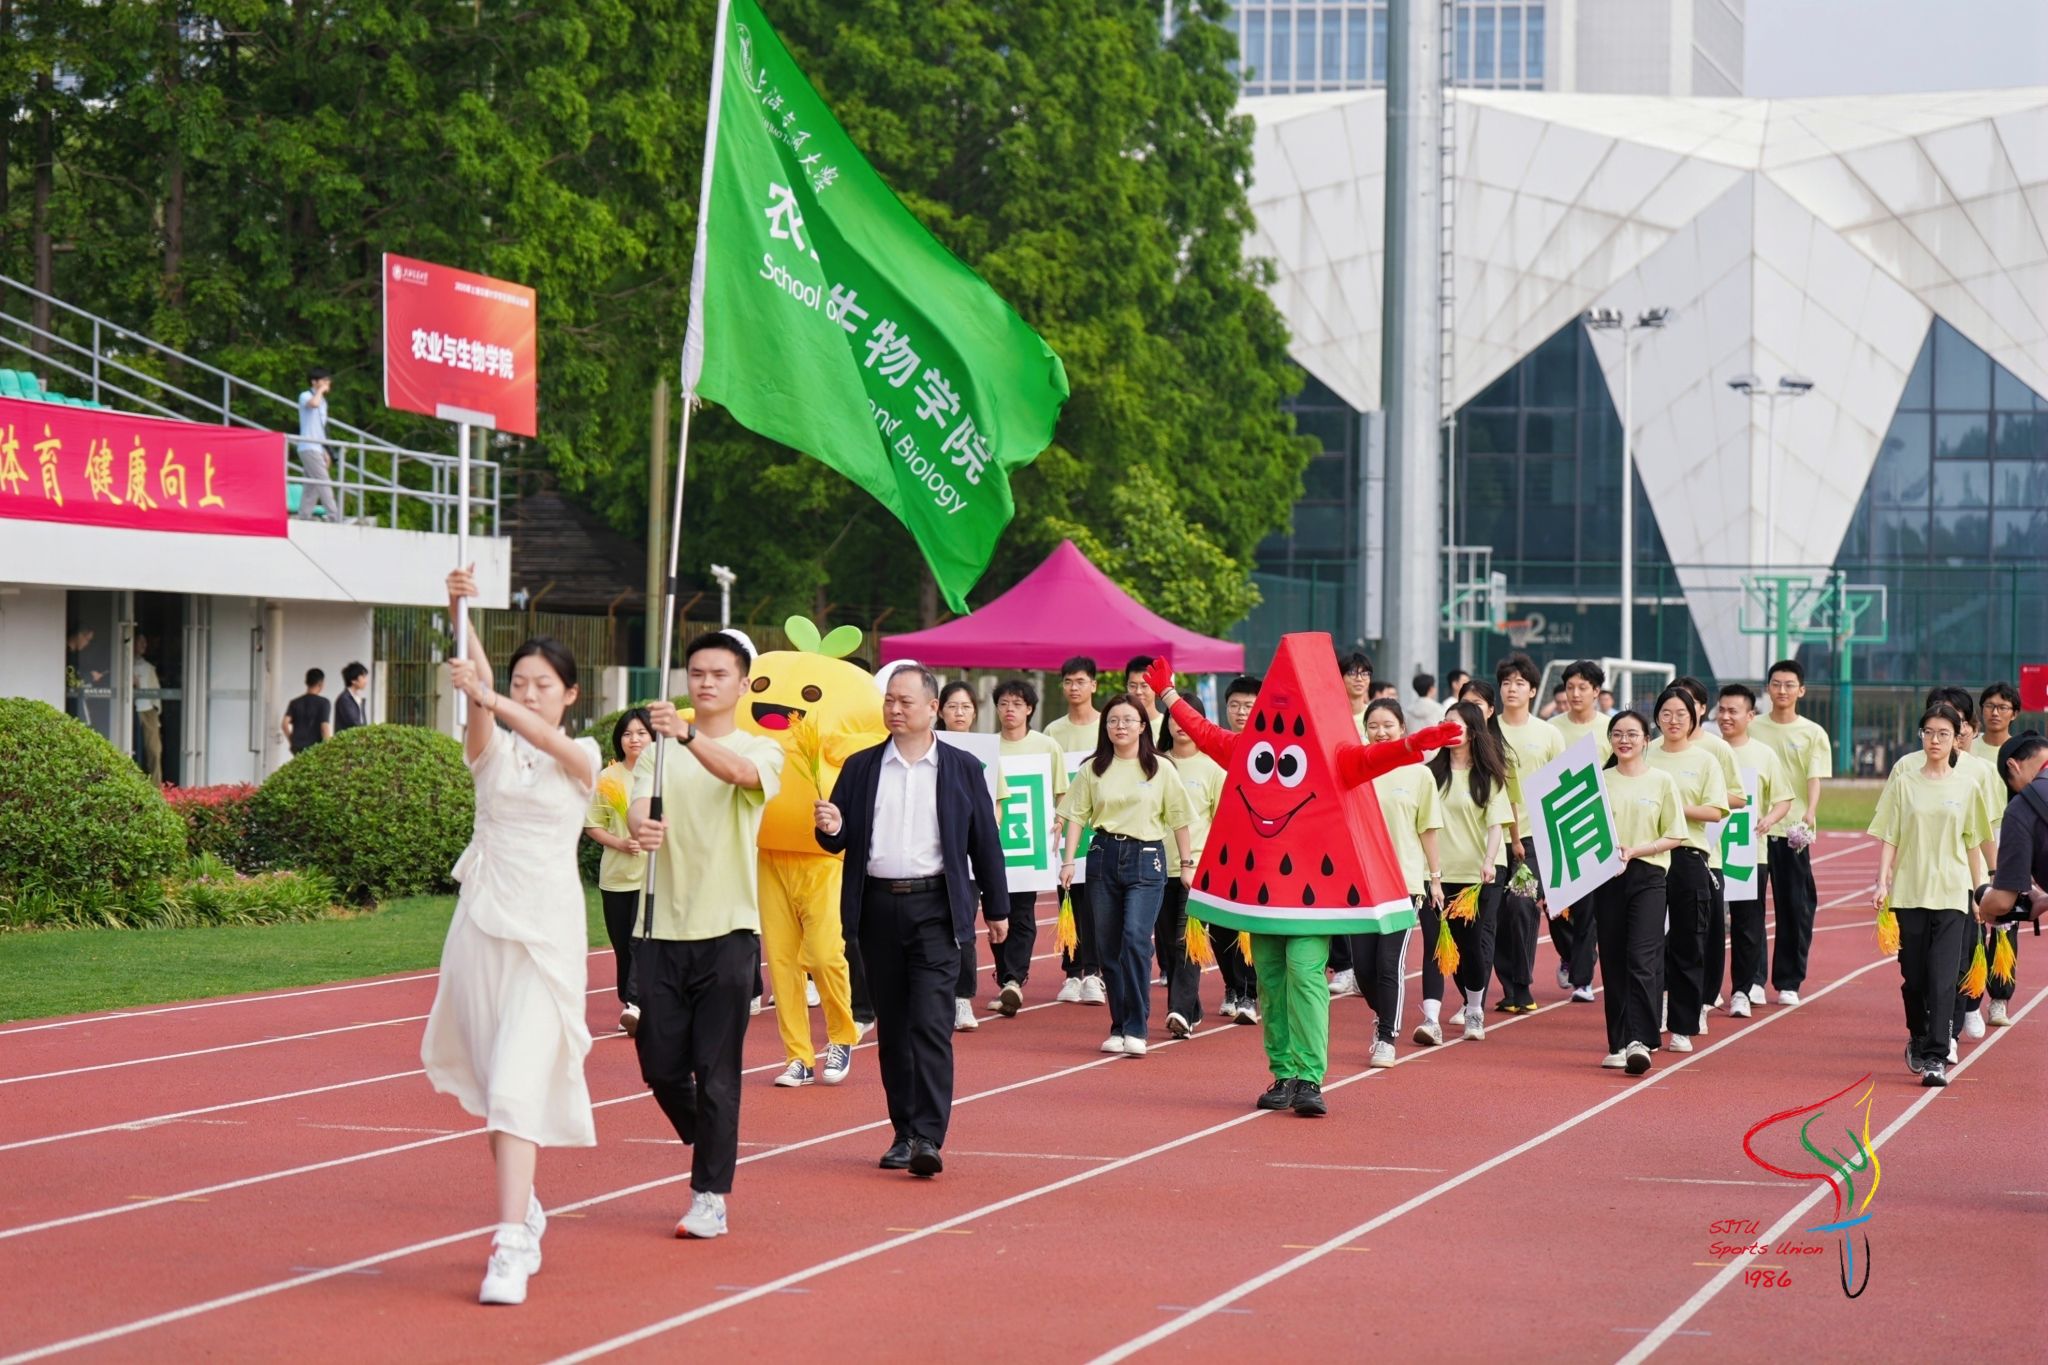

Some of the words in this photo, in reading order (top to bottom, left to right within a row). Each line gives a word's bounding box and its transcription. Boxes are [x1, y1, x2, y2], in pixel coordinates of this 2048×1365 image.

[411, 328, 514, 380] 农业与生物学院
[759, 252, 822, 311] School
[893, 433, 968, 515] Biology
[0, 423, 64, 508] 体育
[84, 434, 225, 512] 健康向上
[1541, 762, 1614, 889] 肩
